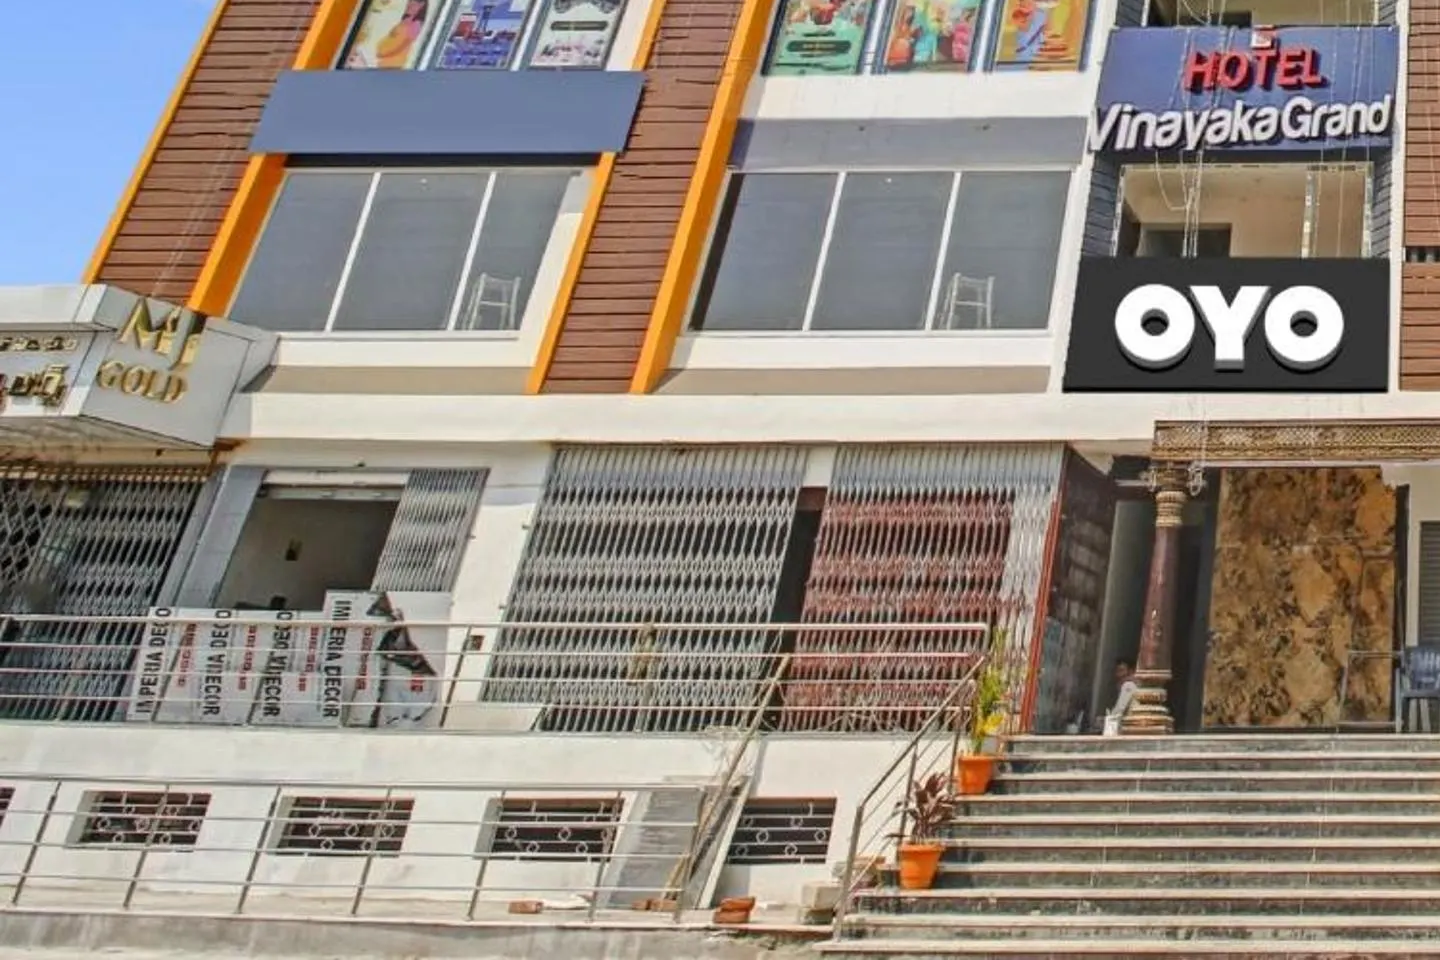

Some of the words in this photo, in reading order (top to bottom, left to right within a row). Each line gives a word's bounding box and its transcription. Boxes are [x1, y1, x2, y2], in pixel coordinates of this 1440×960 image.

[1183, 49, 1325, 90] HOTEL
[1115, 283, 1344, 372] OYO
[96, 359, 189, 404] GOLD
